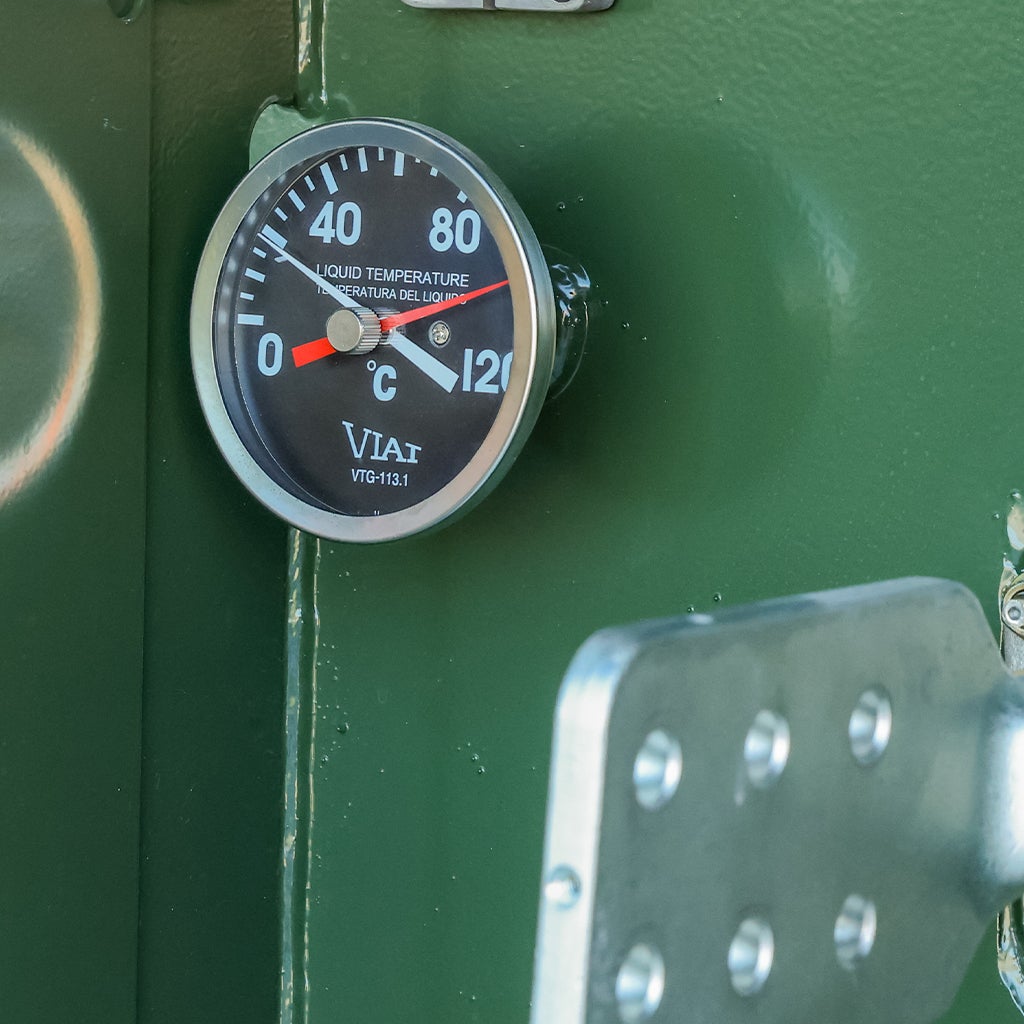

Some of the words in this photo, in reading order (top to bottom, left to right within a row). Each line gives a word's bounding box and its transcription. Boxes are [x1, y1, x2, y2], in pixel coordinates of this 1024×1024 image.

[309, 201, 362, 246] 40
[429, 207, 481, 253] 80
[316, 264, 362, 279] LIQUID
[366, 267, 470, 288] TEMPERATURE
[400, 290, 422, 301] DEL
[258, 333, 283, 376] 0
[351, 468, 409, 487] VTG-113.1
